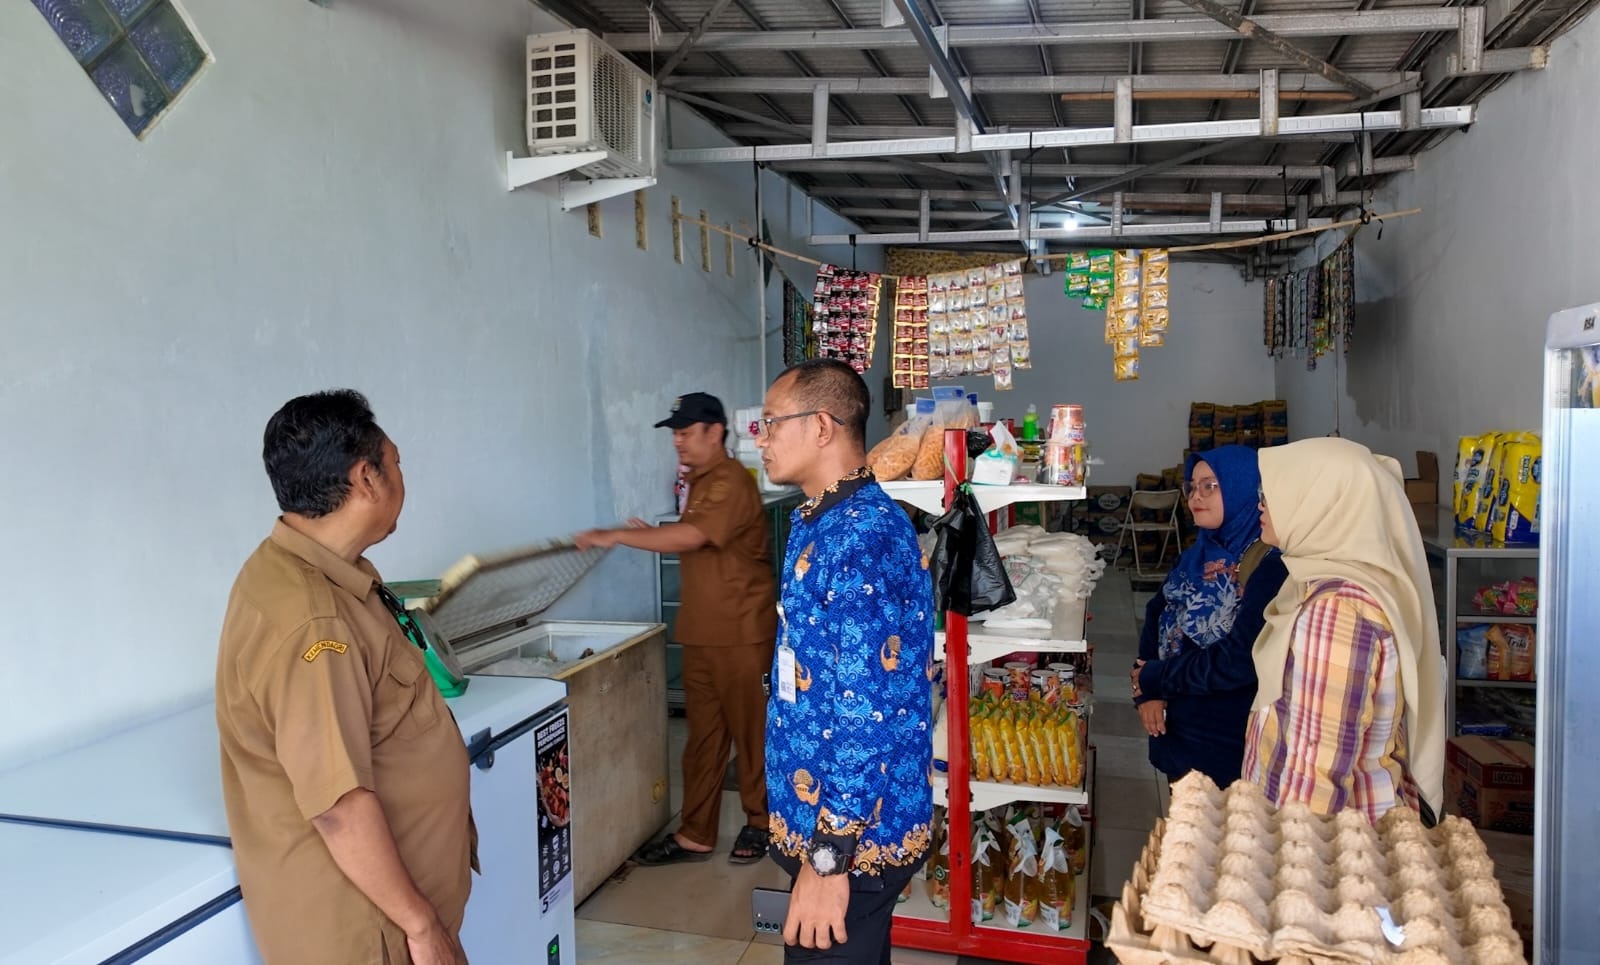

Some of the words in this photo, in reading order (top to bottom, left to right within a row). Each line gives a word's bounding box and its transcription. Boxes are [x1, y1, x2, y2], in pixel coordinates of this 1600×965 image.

[1583, 316, 1597, 331] RSA
[537, 727, 549, 741] BEST
[542, 896, 549, 914] 5
